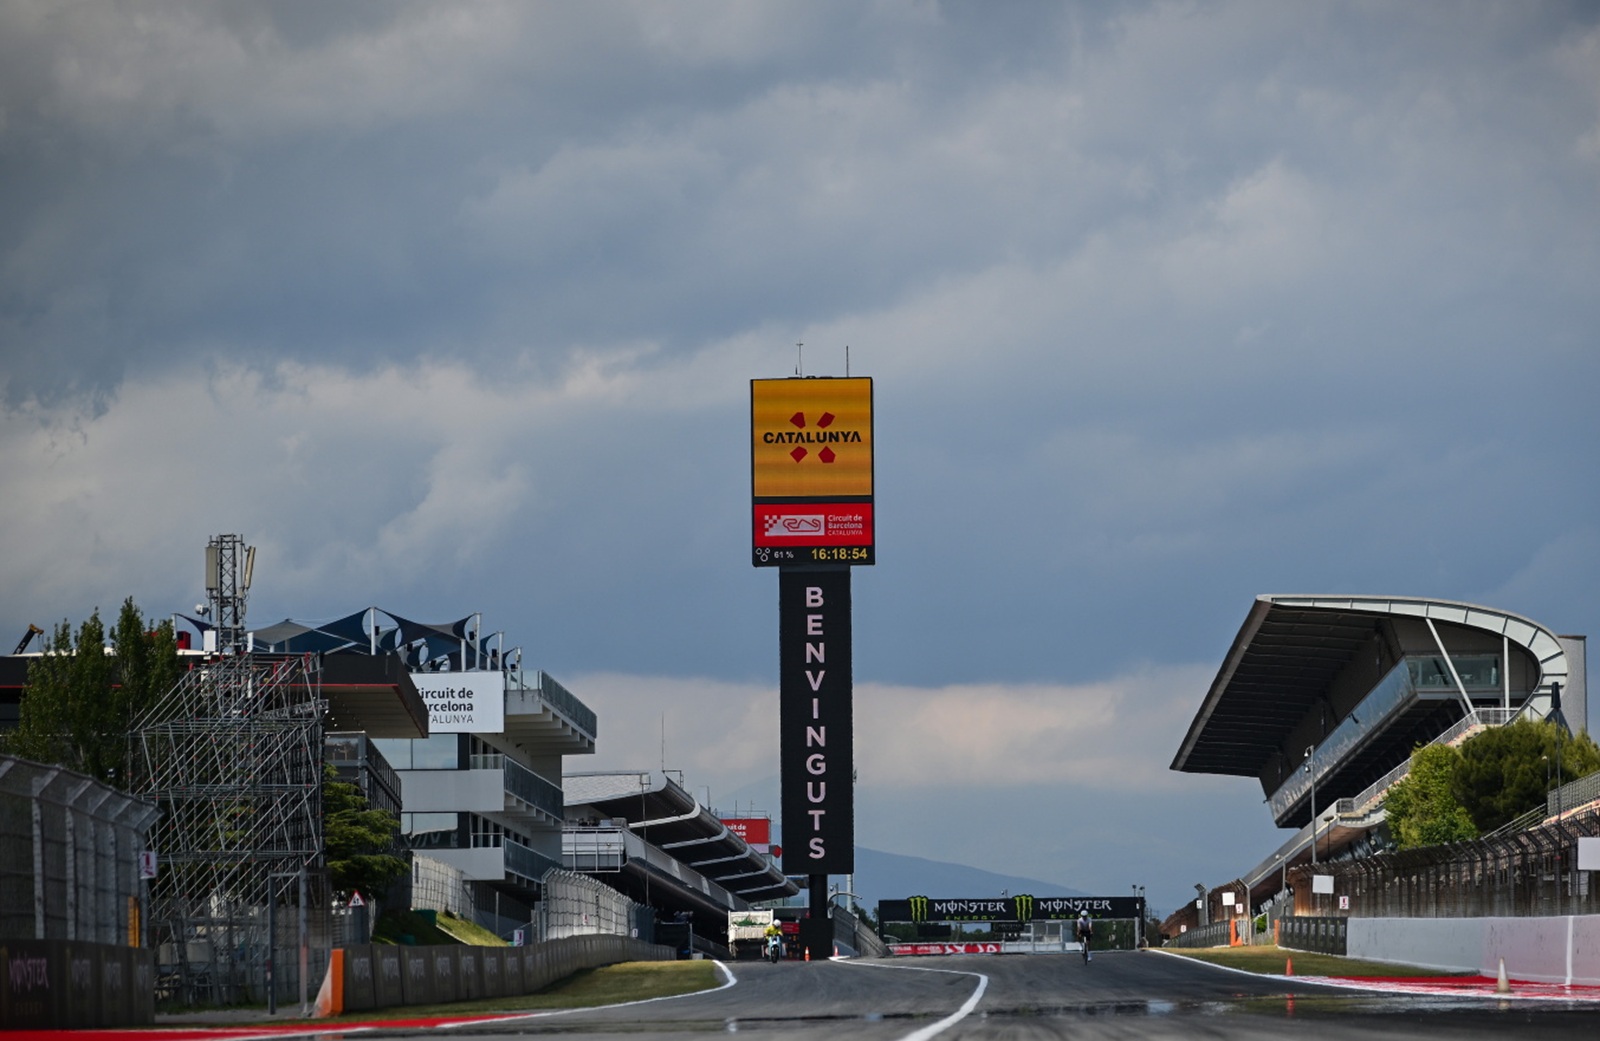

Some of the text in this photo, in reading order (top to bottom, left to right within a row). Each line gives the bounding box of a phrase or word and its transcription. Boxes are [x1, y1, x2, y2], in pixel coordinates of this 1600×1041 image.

[763, 431, 862, 443] CATALUNYA
[811, 548, 868, 560] 16:18:54
[417, 687, 474, 699] ircuit de
[805, 586, 826, 860] BENVINGUTS
[934, 900, 1007, 914] MONSTER
[1040, 898, 1112, 912] MONSTER
